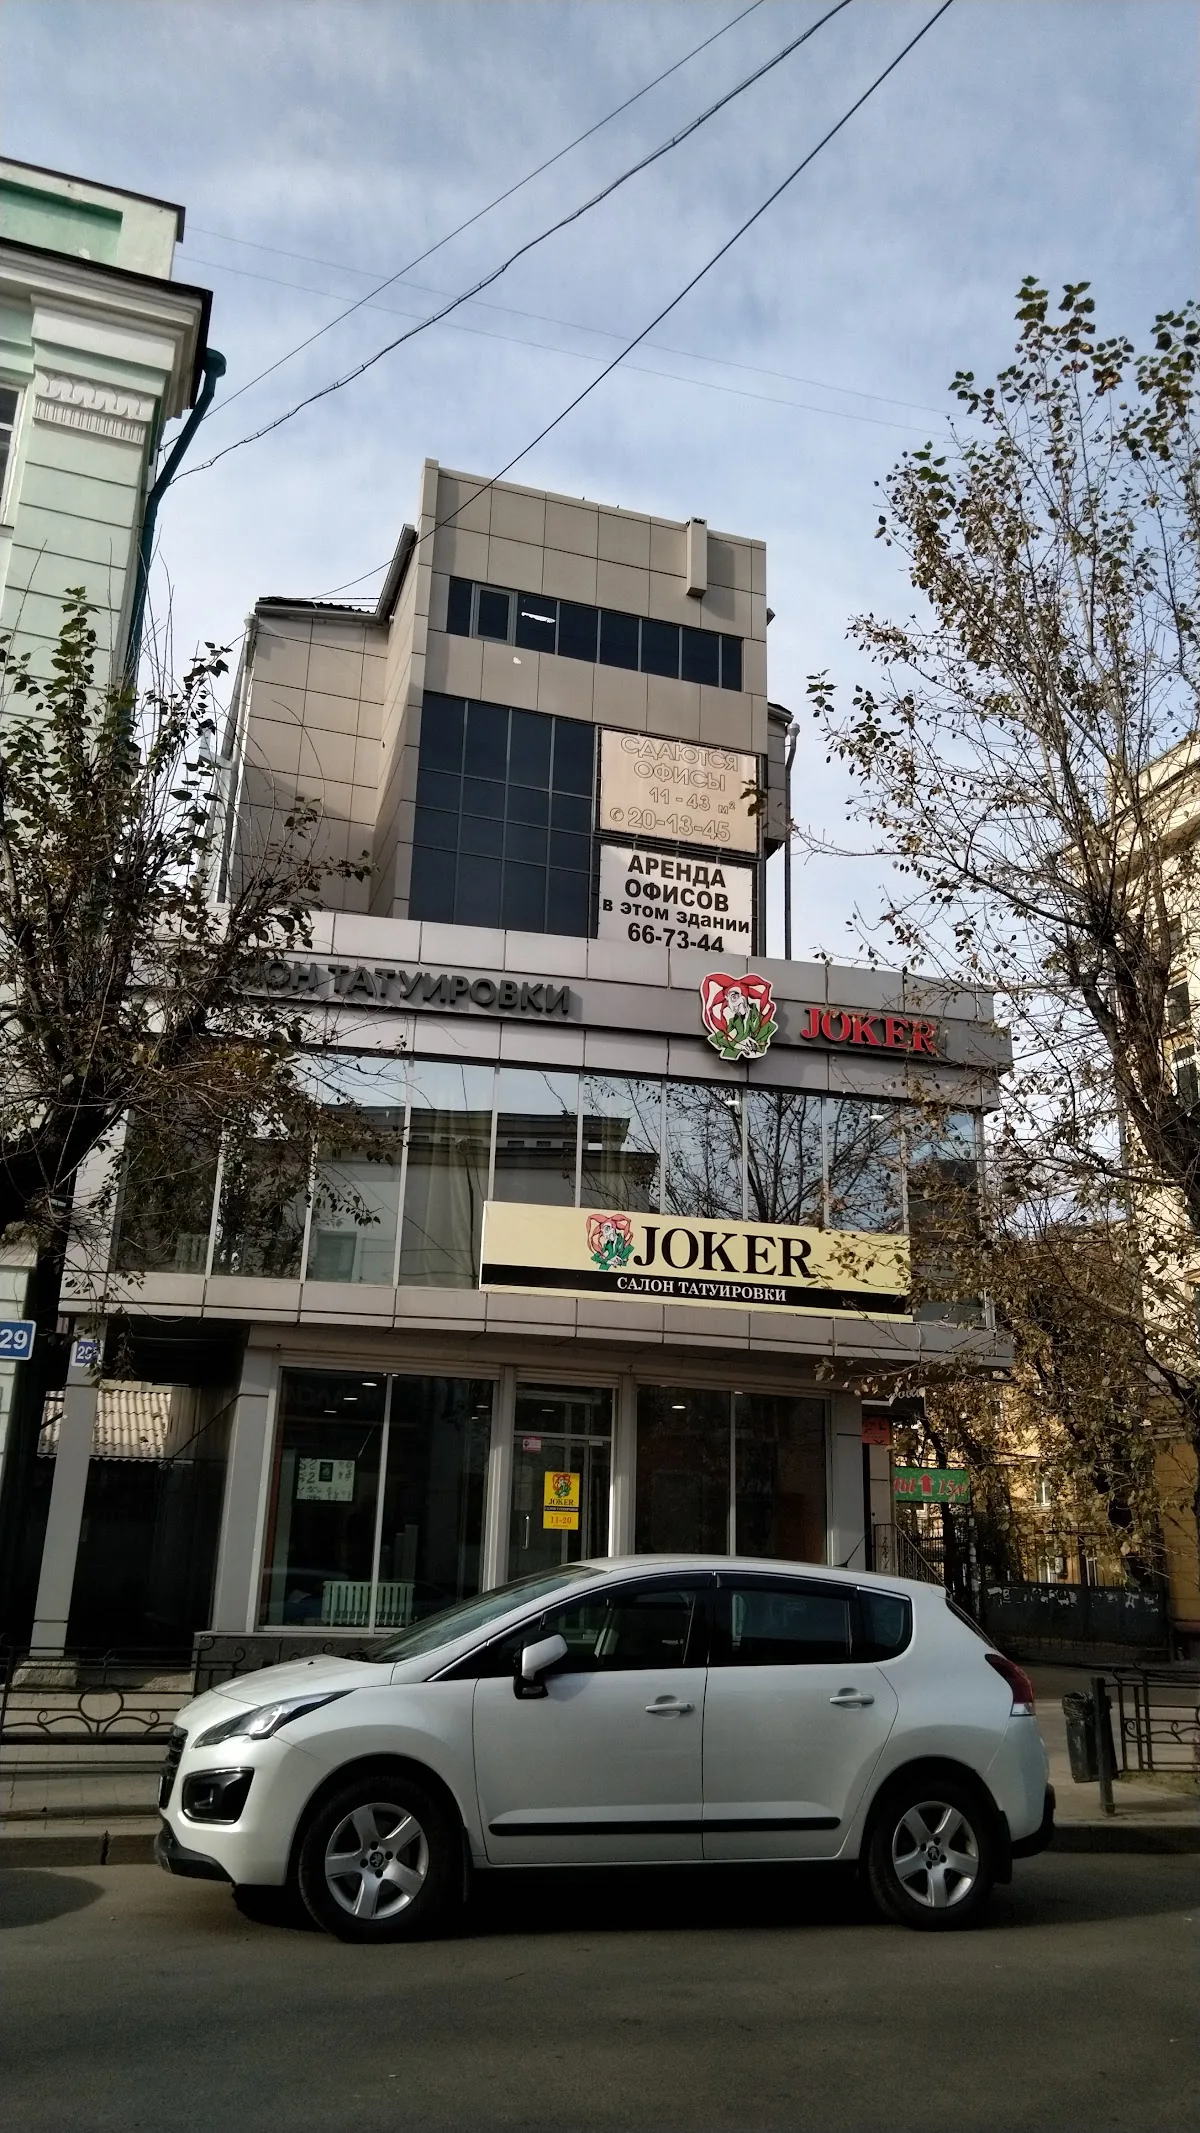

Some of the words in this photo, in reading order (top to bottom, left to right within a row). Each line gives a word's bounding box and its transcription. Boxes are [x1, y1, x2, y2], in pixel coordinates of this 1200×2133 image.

[620, 735, 739, 772] СДАЮТСЯ
[633, 760, 726, 792] ОФИСЫ
[649, 786, 670, 805] 11
[686, 793, 711, 812] 43
[627, 806, 731, 843] 20-13-45
[627, 854, 727, 889] АРЕНДА
[624, 878, 730, 913] ОФИСОВ
[620, 899, 669, 921] этом
[676, 910, 750, 934] здании
[627, 922, 725, 953] 66-73-44
[328, 964, 572, 1014] ТАТУИРОВКИ
[800, 1006, 938, 1054] JOKER
[633, 1225, 820, 1279] JOKER
[617, 1276, 675, 1293] САЛОН
[678, 1281, 787, 1303] ТАТУИРОВКИ
[0, 1328, 28, 1350] 29
[548, 1498, 574, 1506] JOKER
[550, 1515, 572, 1524] 11-20
